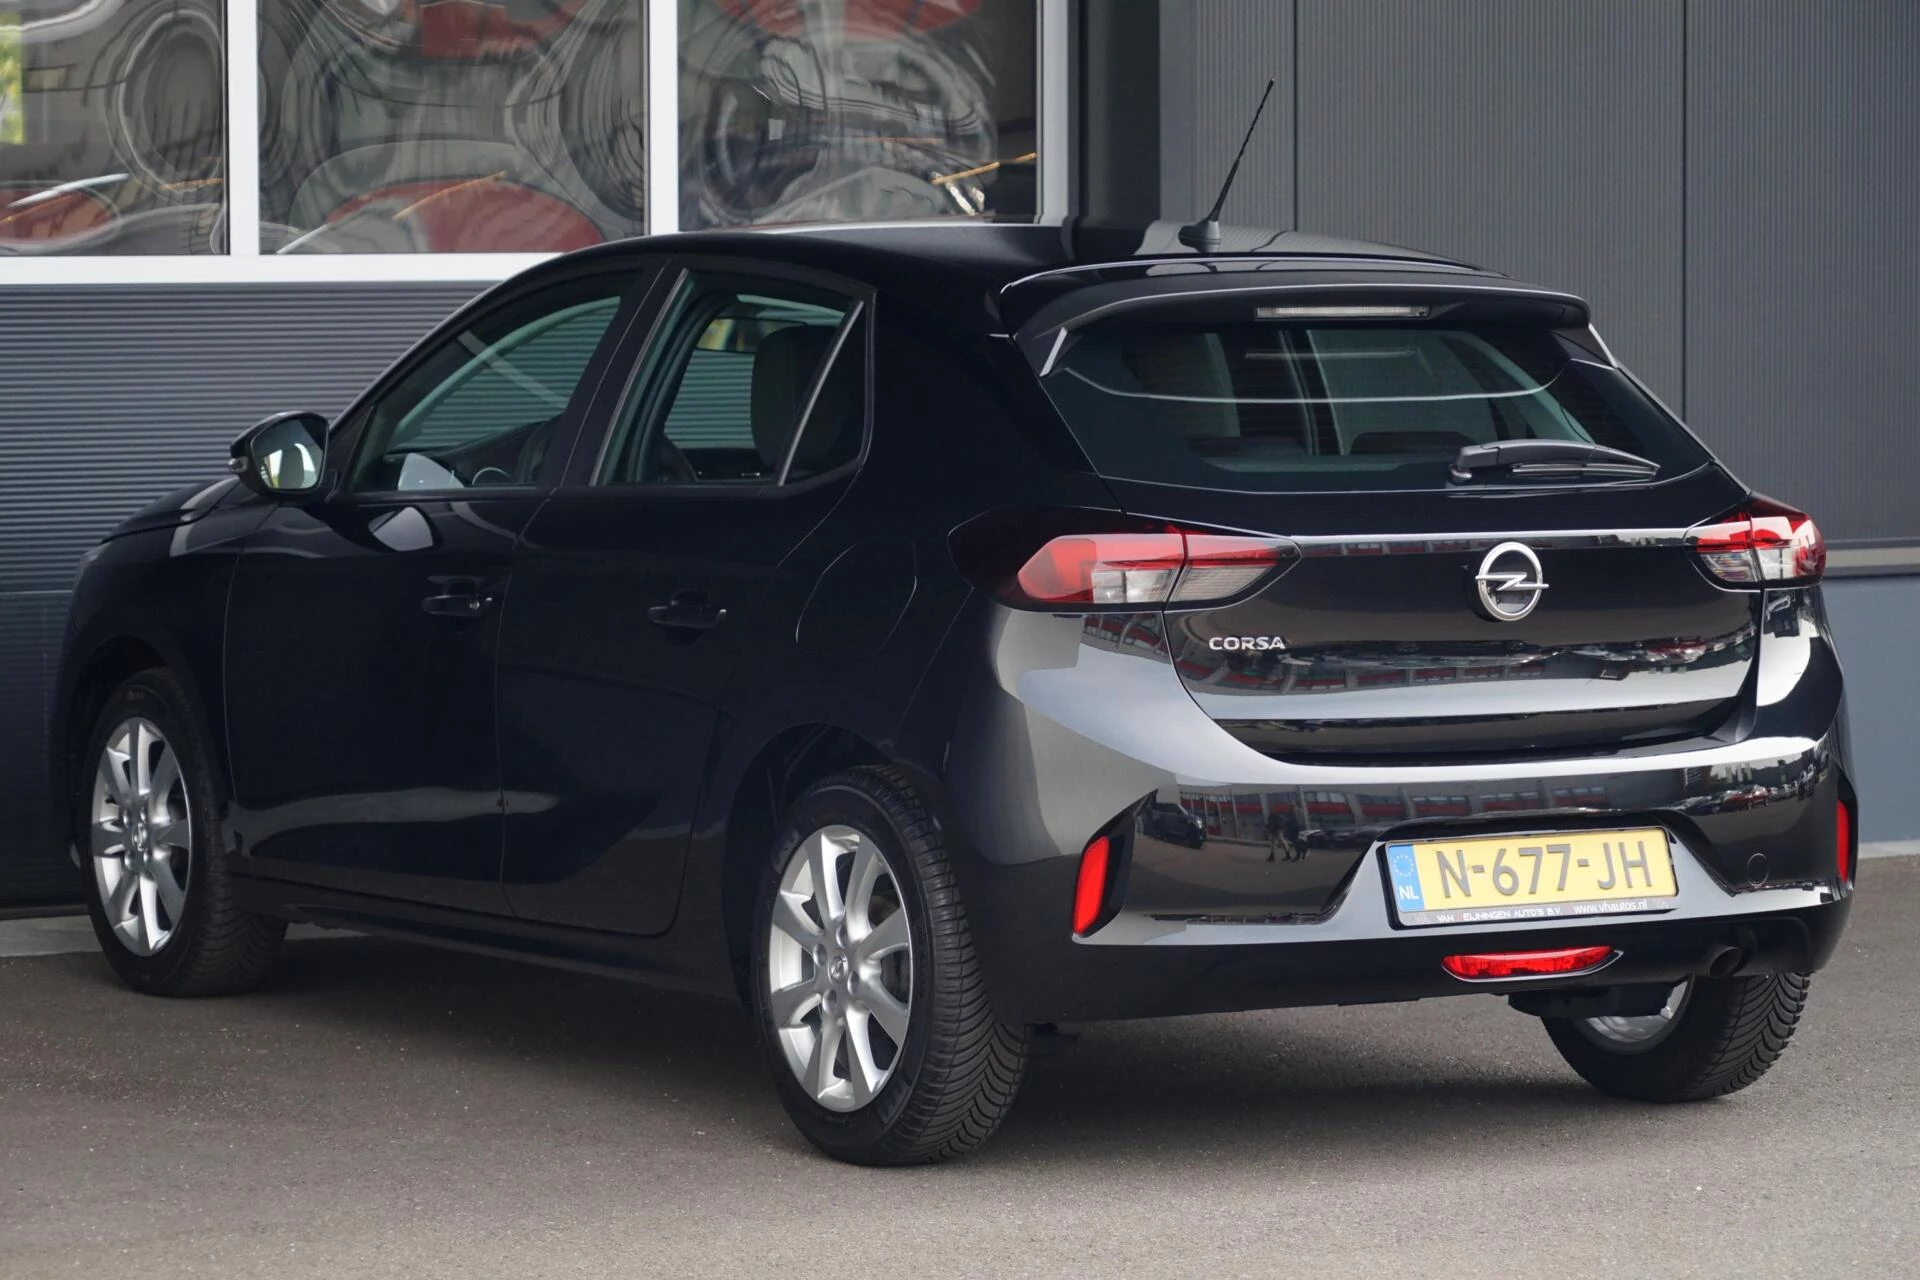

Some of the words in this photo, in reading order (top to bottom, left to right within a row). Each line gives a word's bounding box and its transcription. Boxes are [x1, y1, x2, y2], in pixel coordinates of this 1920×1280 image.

[1208, 636, 1286, 650] CORSA
[1436, 840, 1653, 898] N-677-JH
[1399, 885, 1420, 900] NL
[1572, 899, 1649, 914] www.vhautos.nl
[1436, 913, 1455, 923] VAN
